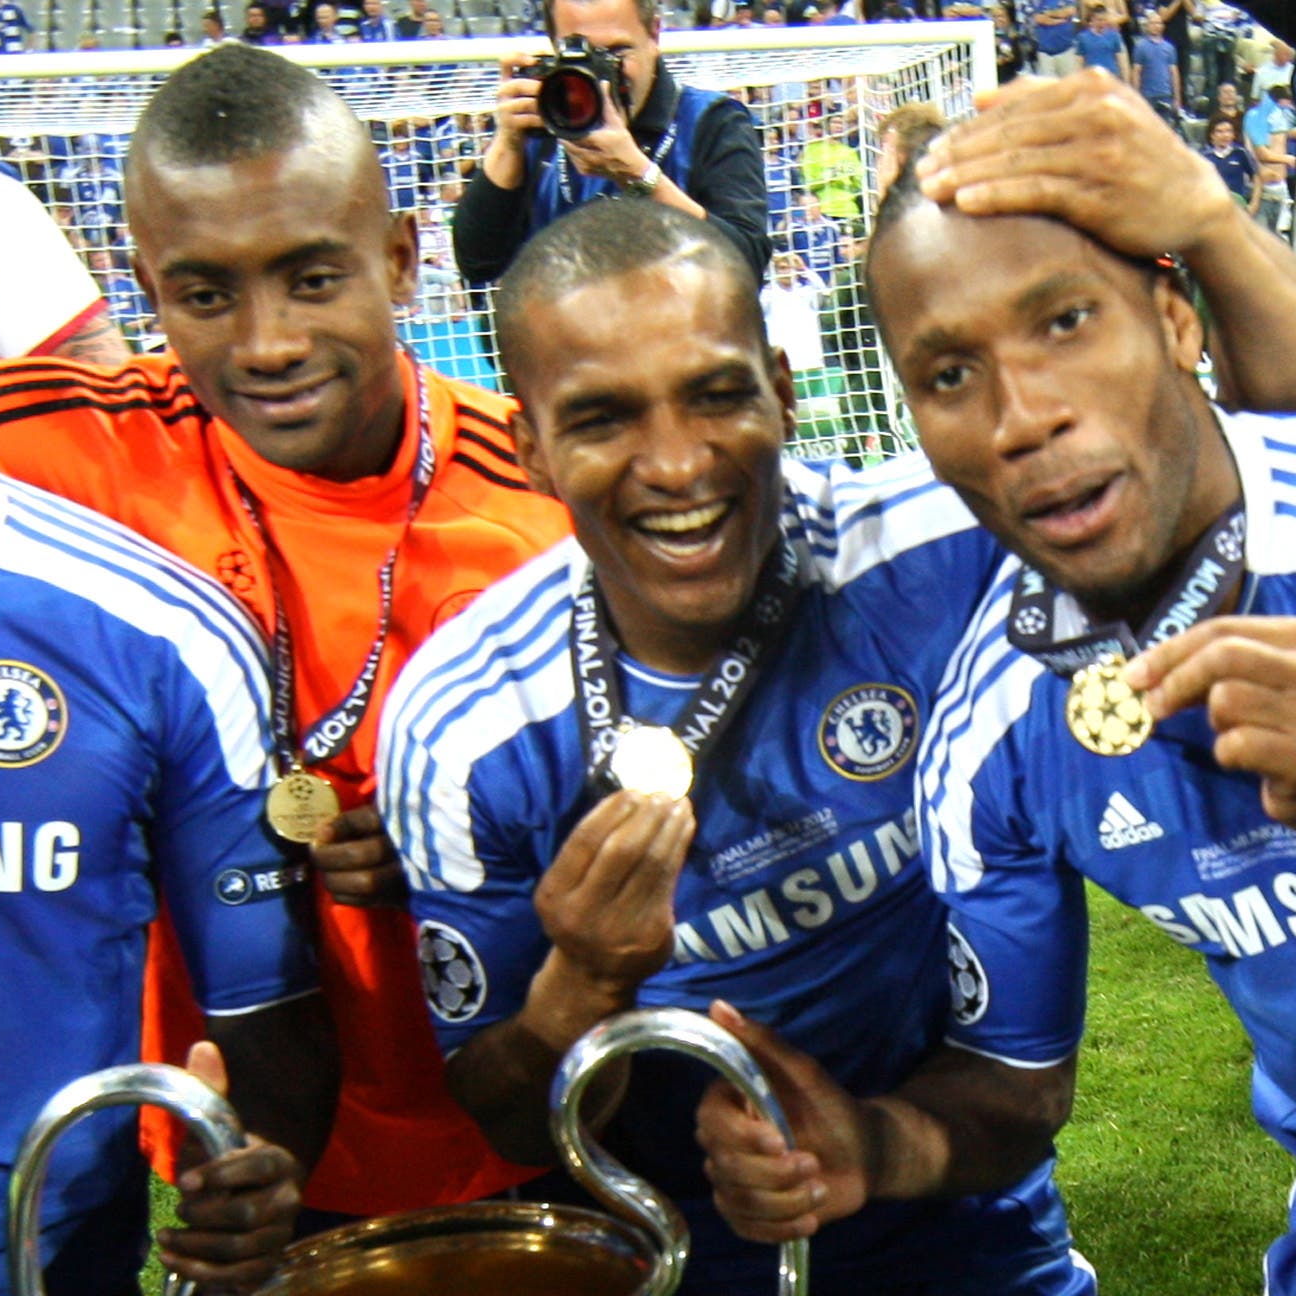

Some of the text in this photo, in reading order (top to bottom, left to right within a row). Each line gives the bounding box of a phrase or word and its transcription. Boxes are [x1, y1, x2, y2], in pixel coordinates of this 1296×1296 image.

[574, 596, 604, 678] FINAL
[682, 636, 760, 755] NAL 2012
[828, 689, 888, 724] CHELSEA
[304, 709, 358, 758] 2012
[1099, 821, 1165, 850] adidas
[673, 807, 921, 964] AMSUN
